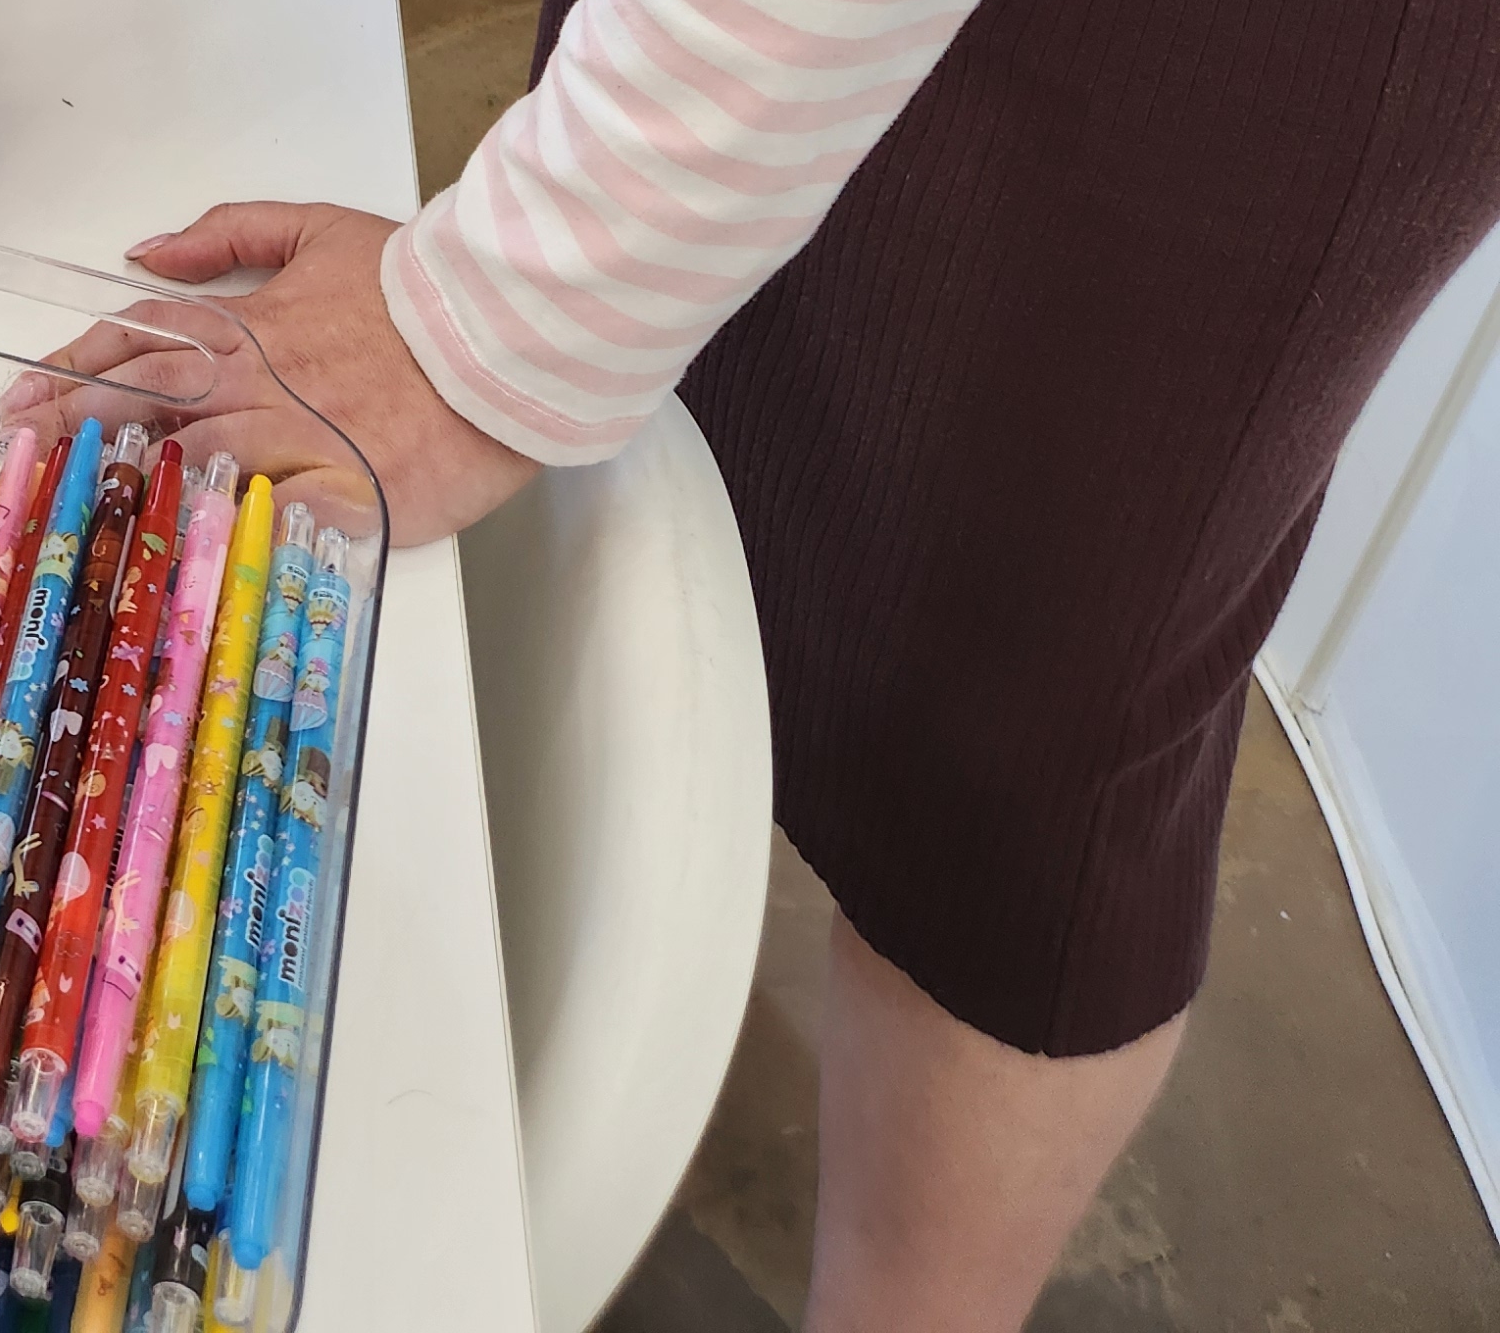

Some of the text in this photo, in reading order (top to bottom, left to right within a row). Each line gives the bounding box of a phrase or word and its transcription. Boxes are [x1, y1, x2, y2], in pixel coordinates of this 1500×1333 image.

[19, 589, 48, 680] monizoo
[248, 835, 274, 947] monizoo
[280, 868, 307, 983] monizoo
